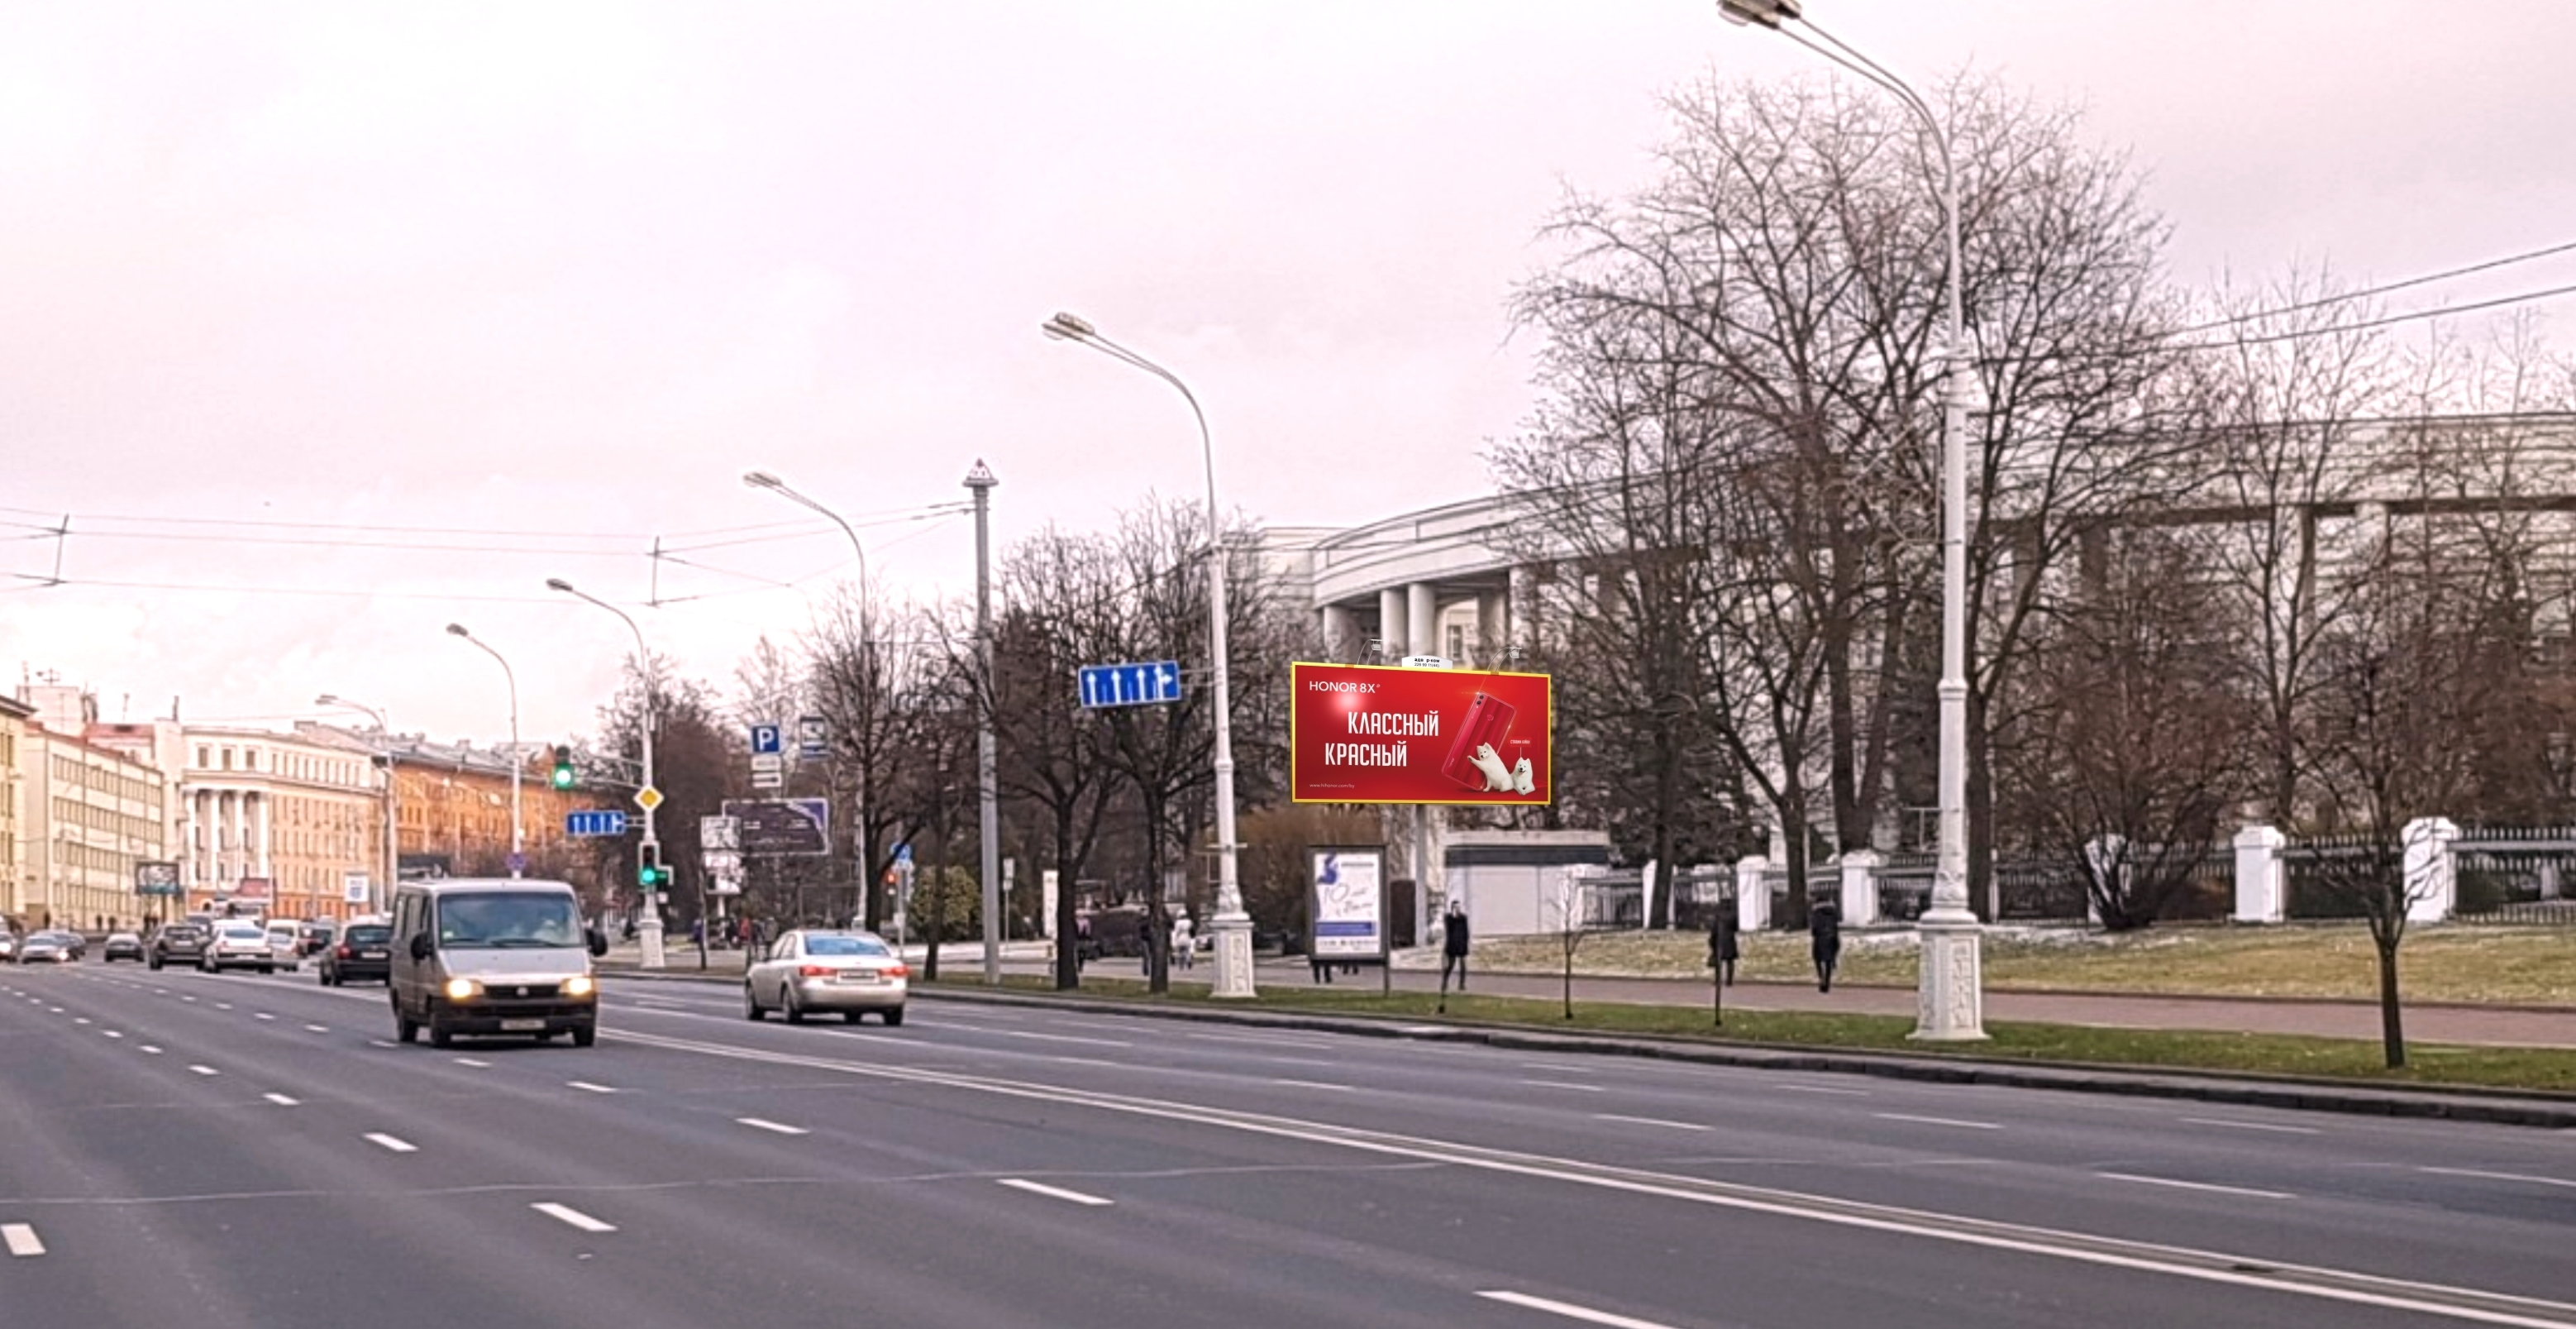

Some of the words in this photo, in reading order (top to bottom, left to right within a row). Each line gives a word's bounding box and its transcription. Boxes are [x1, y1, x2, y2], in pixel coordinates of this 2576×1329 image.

[1309, 681, 1357, 693] HONOR
[1348, 710, 1439, 737] КЛАССНЫЙ
[1325, 740, 1407, 767] КРАСНЫЙ
